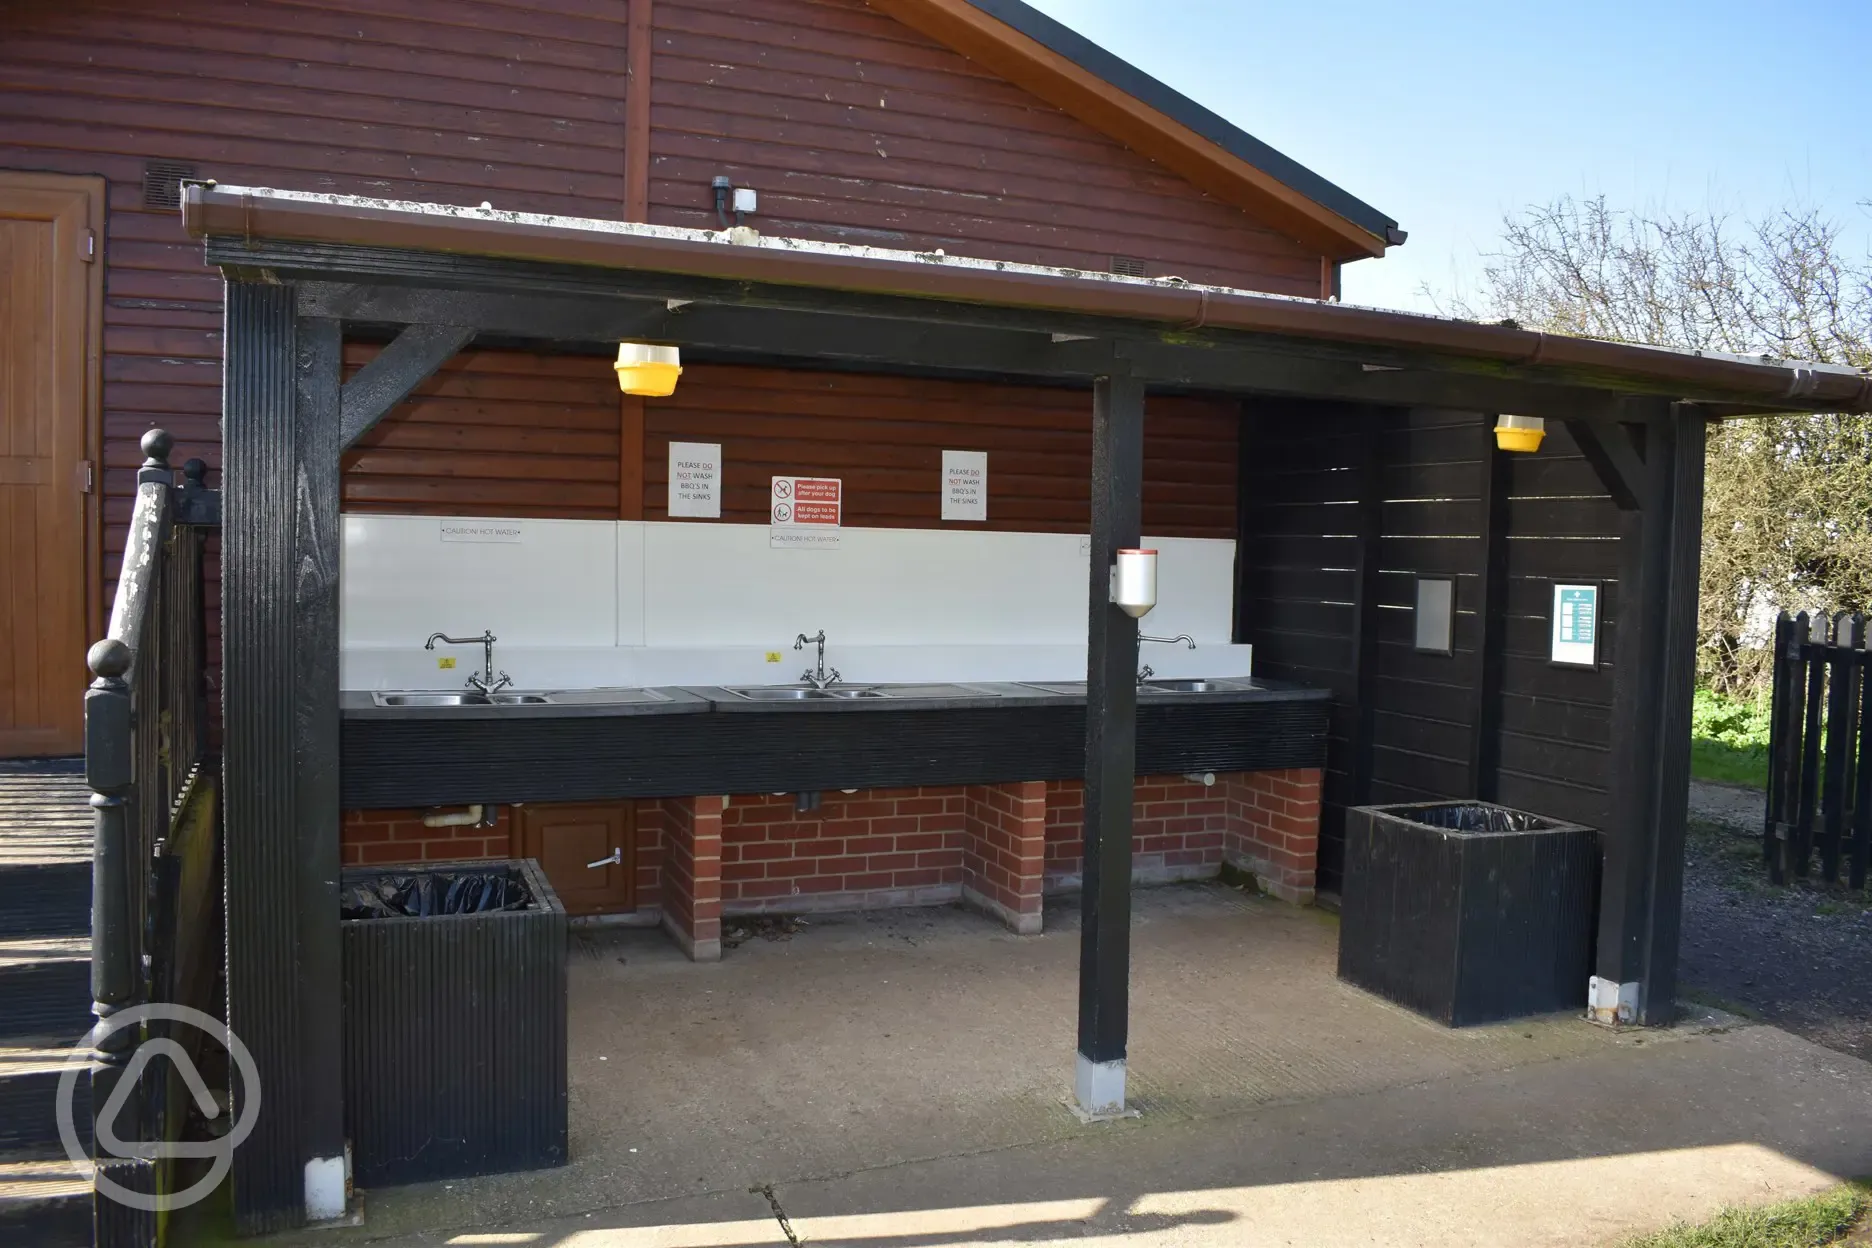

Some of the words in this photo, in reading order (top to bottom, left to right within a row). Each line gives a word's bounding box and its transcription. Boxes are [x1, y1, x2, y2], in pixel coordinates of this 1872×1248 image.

[677, 461, 701, 469] PLEASE
[702, 462, 713, 470] DO
[949, 468, 970, 476] PLEASE
[970, 469, 980, 477] DO
[680, 482, 700, 490] BBQ'S
[948, 478, 961, 486] NOT
[951, 487, 969, 495] BBQ'S
[678, 492, 691, 500] THE
[692, 493, 711, 501] SINKS
[806, 506, 820, 514] dogs
[797, 512, 809, 520] kept
[495, 528, 518, 536] WATER
